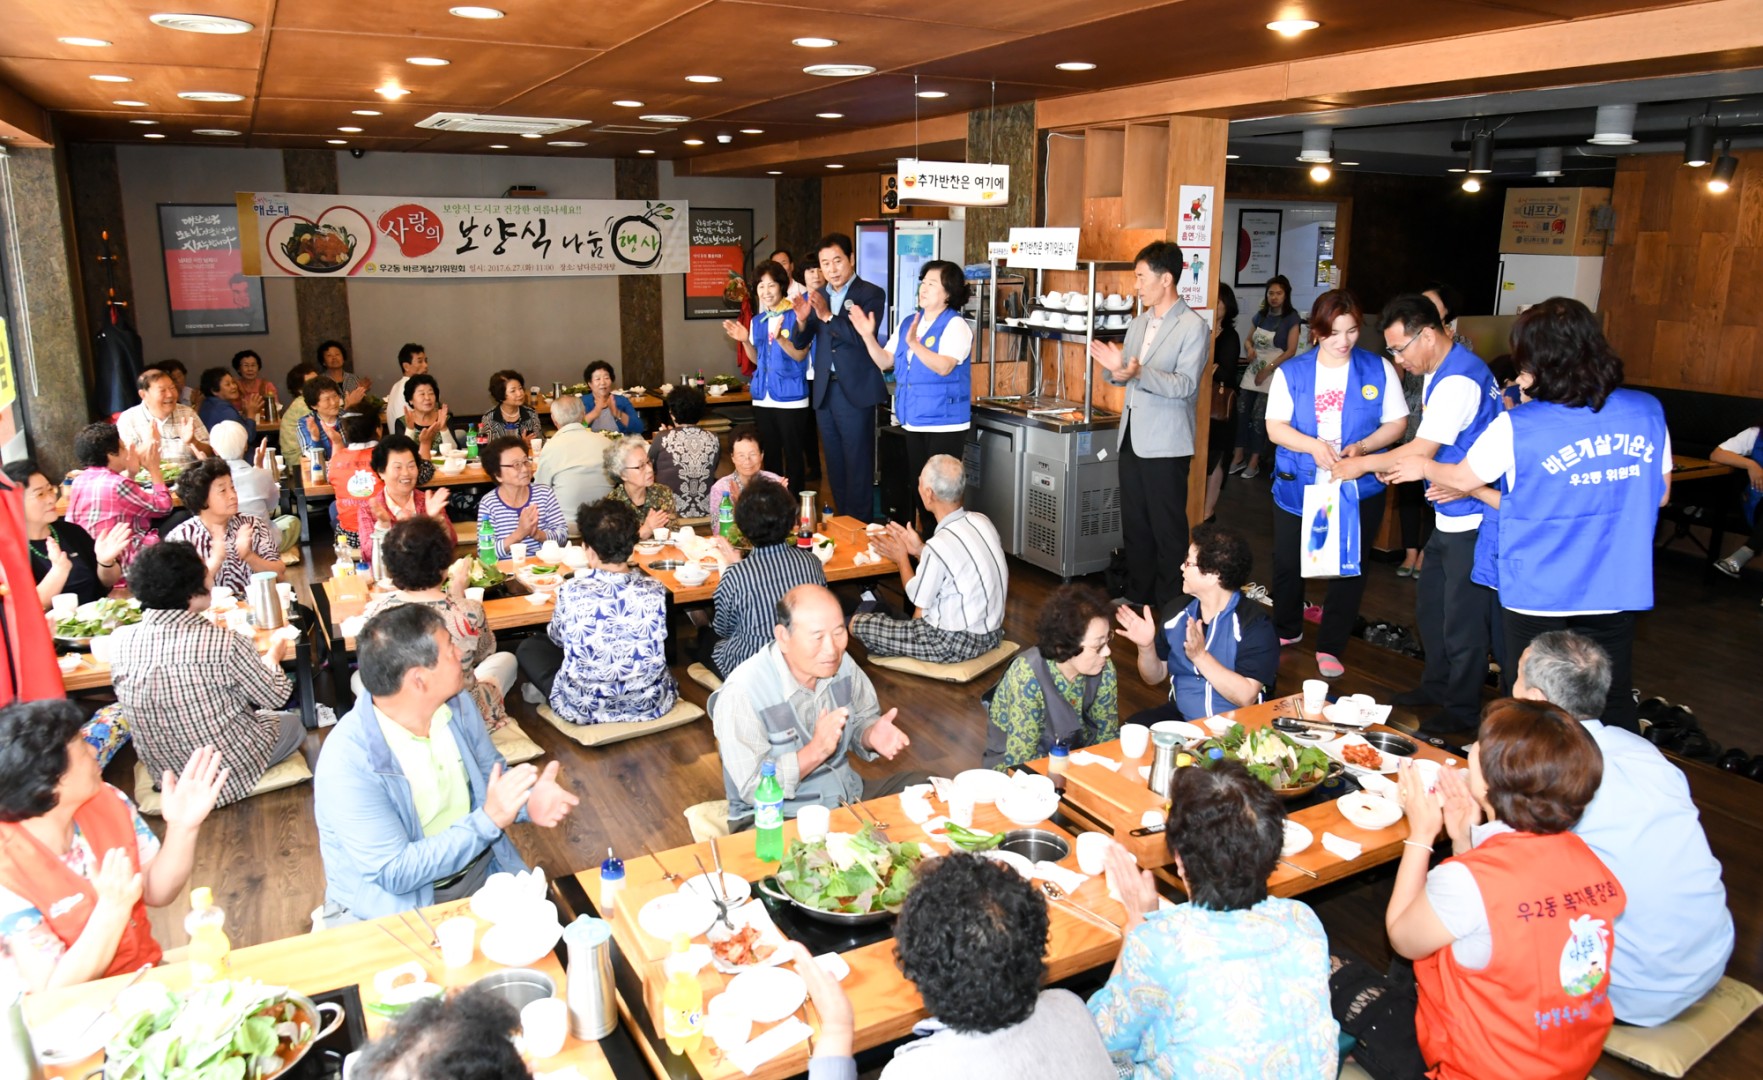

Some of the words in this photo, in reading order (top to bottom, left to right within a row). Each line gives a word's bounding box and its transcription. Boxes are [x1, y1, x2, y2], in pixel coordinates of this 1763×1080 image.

[917, 174, 971, 190] 추가반찬은
[974, 176, 1005, 190] 여기에
[253, 204, 290, 217] 해운대
[443, 204, 471, 215] 보양식
[473, 204, 500, 215] 드시고
[504, 204, 531, 215] 건강한
[533, 204, 582, 215] 여름나세요!!
[1523, 204, 1559, 217] 내프킨
[384, 211, 441, 244] 사랑의
[455, 216, 552, 259] 보양식
[562, 230, 605, 259] 나눔
[618, 229, 660, 253] 행사
[1182, 231, 1206, 241] 흡연가능
[379, 264, 401, 273] 우2동
[402, 264, 466, 273] 바르게살기위원회
[469, 264, 486, 273] 일시:
[535, 263, 554, 272] 11:00
[560, 263, 575, 272] 장소:
[576, 262, 616, 272] 남다른감자탕
[1182, 293, 1203, 303] 주가능
[1568, 471, 1603, 486] 우2동
[1605, 464, 1641, 482] 위원회
[1516, 896, 1558, 922] 우2동
[1563, 881, 1618, 911] 복지통장회
